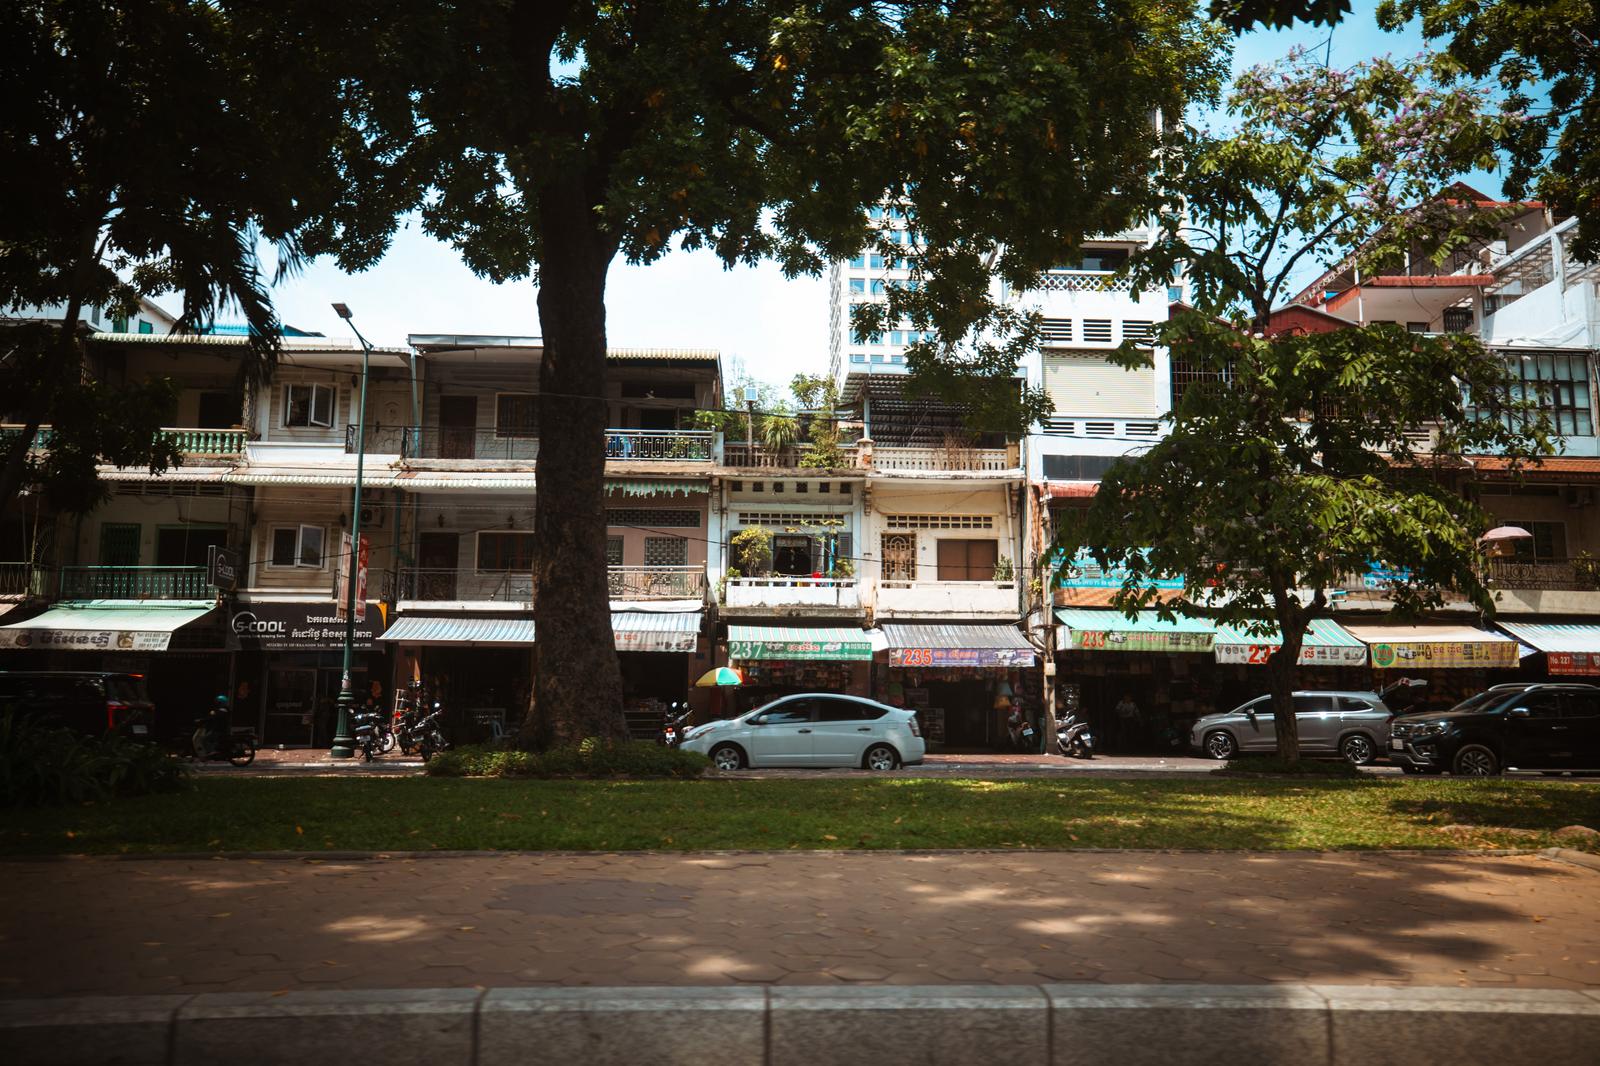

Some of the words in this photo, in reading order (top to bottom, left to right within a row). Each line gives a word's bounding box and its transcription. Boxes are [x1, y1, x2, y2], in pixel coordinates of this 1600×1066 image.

[236, 621, 286, 633] S-COOL
[1082, 631, 1105, 647] 233
[730, 641, 763, 659] 237
[903, 648, 933, 665] 235
[1248, 644, 1281, 664] 23
[1560, 655, 1571, 665] 227
